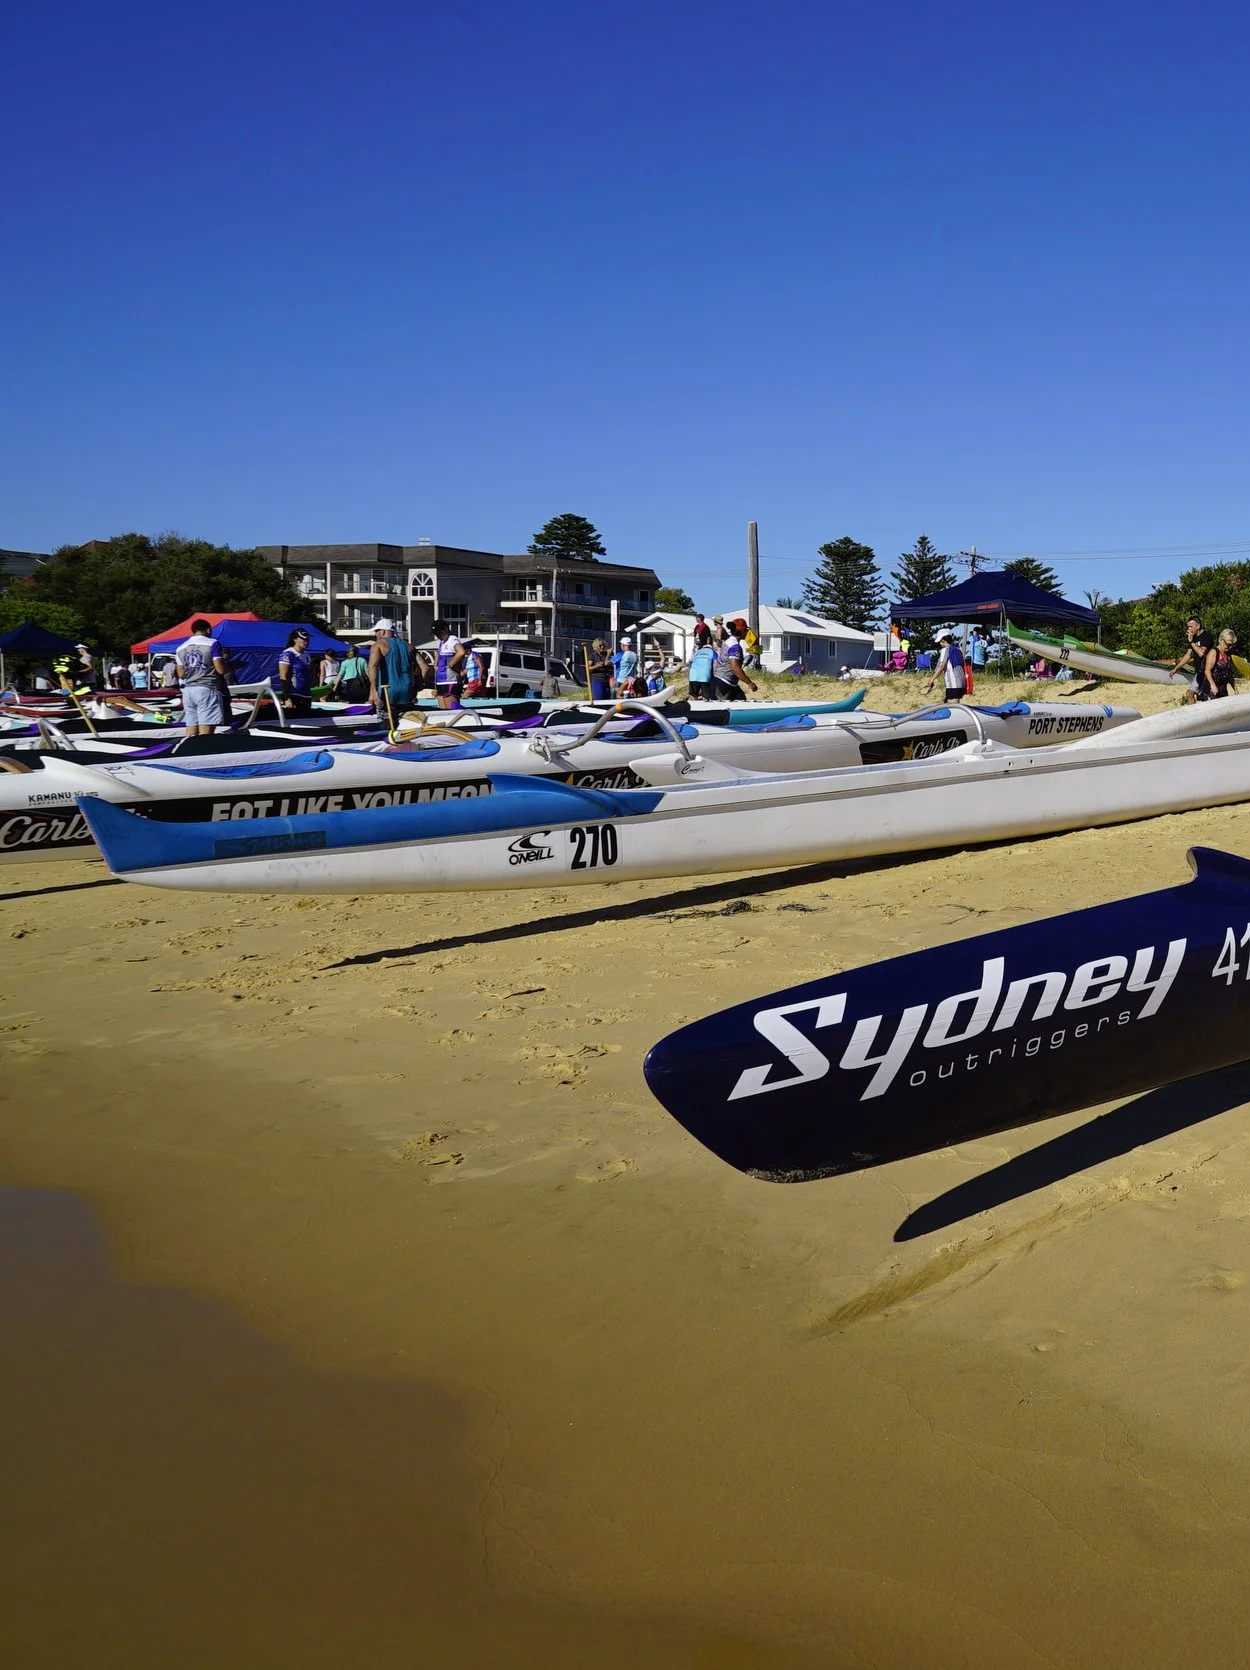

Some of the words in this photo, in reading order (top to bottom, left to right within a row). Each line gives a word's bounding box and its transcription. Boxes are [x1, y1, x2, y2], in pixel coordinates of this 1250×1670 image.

[1028, 717, 1056, 735] PORT
[1057, 716, 1104, 733] STEPHENS
[28, 791, 72, 803] KAMANU
[569, 823, 618, 870] 270
[727, 937, 1188, 1102] Sydney
[909, 1009, 1131, 1087] outriggers
